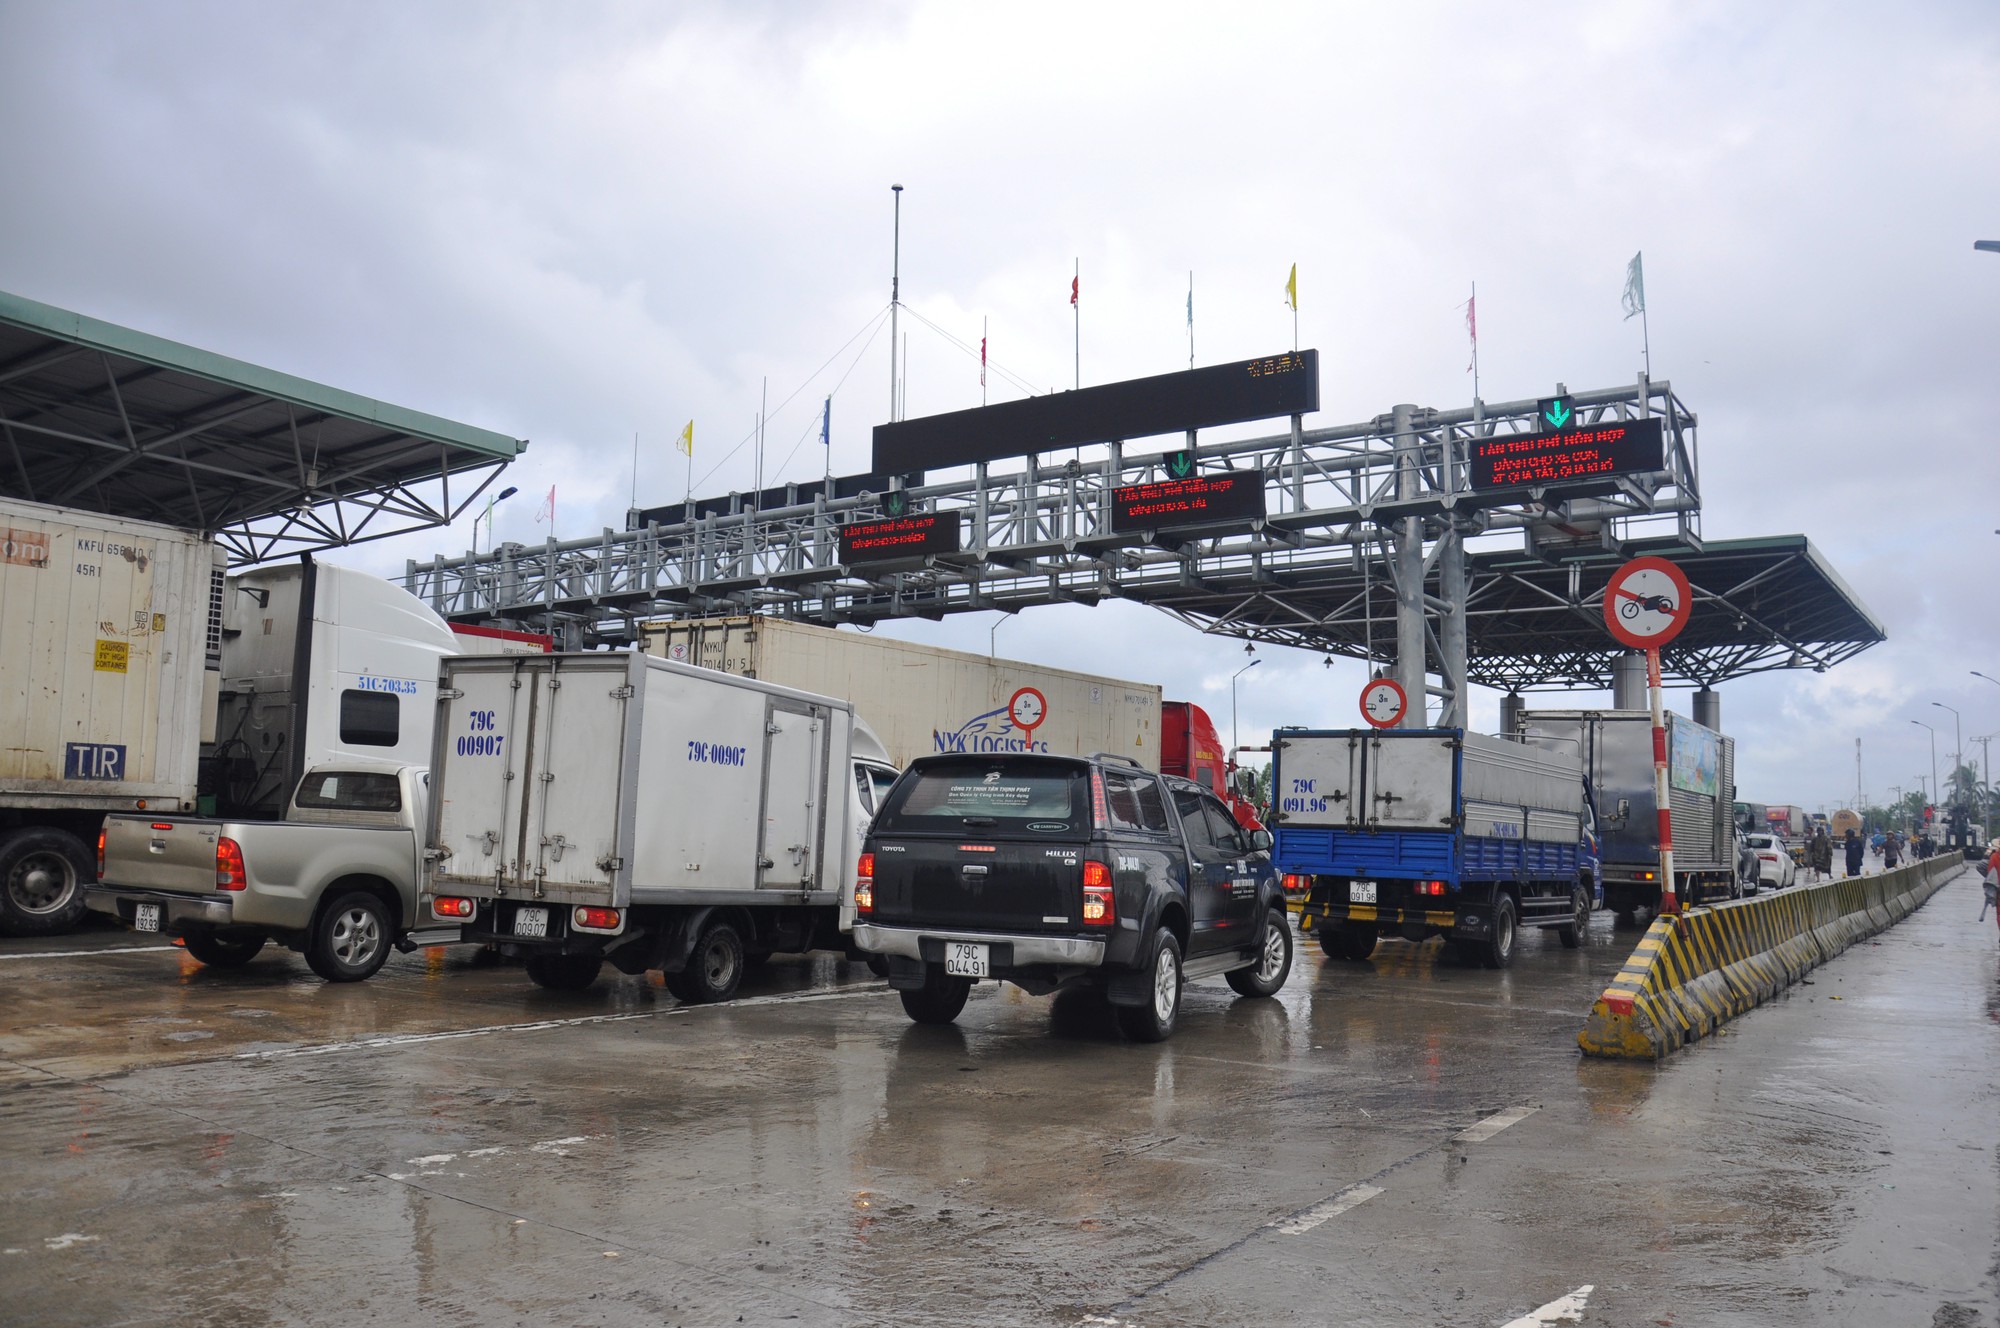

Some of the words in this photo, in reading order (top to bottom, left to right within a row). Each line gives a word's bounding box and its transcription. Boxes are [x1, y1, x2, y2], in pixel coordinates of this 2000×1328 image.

[78, 539, 103, 552] KKFU
[76, 563, 102, 577] 45R1
[704, 641, 723, 653] NYKU
[358, 676, 417, 694] 51C-703.35
[469, 710, 495, 731] 79C
[457, 735, 504, 756] 00907
[933, 729, 967, 752] NYK
[1292, 779, 1317, 794] 79C
[1283, 797, 1327, 813] 091.96
[1045, 850, 1076, 858] HILUX
[1356, 883, 1371, 892] 79C
[1351, 892, 1376, 902] 091.96
[141, 905, 154, 918] 37C
[524, 909, 541, 922] 79C
[956, 945, 979, 960] 79C
[947, 960, 986, 975] 044.91
